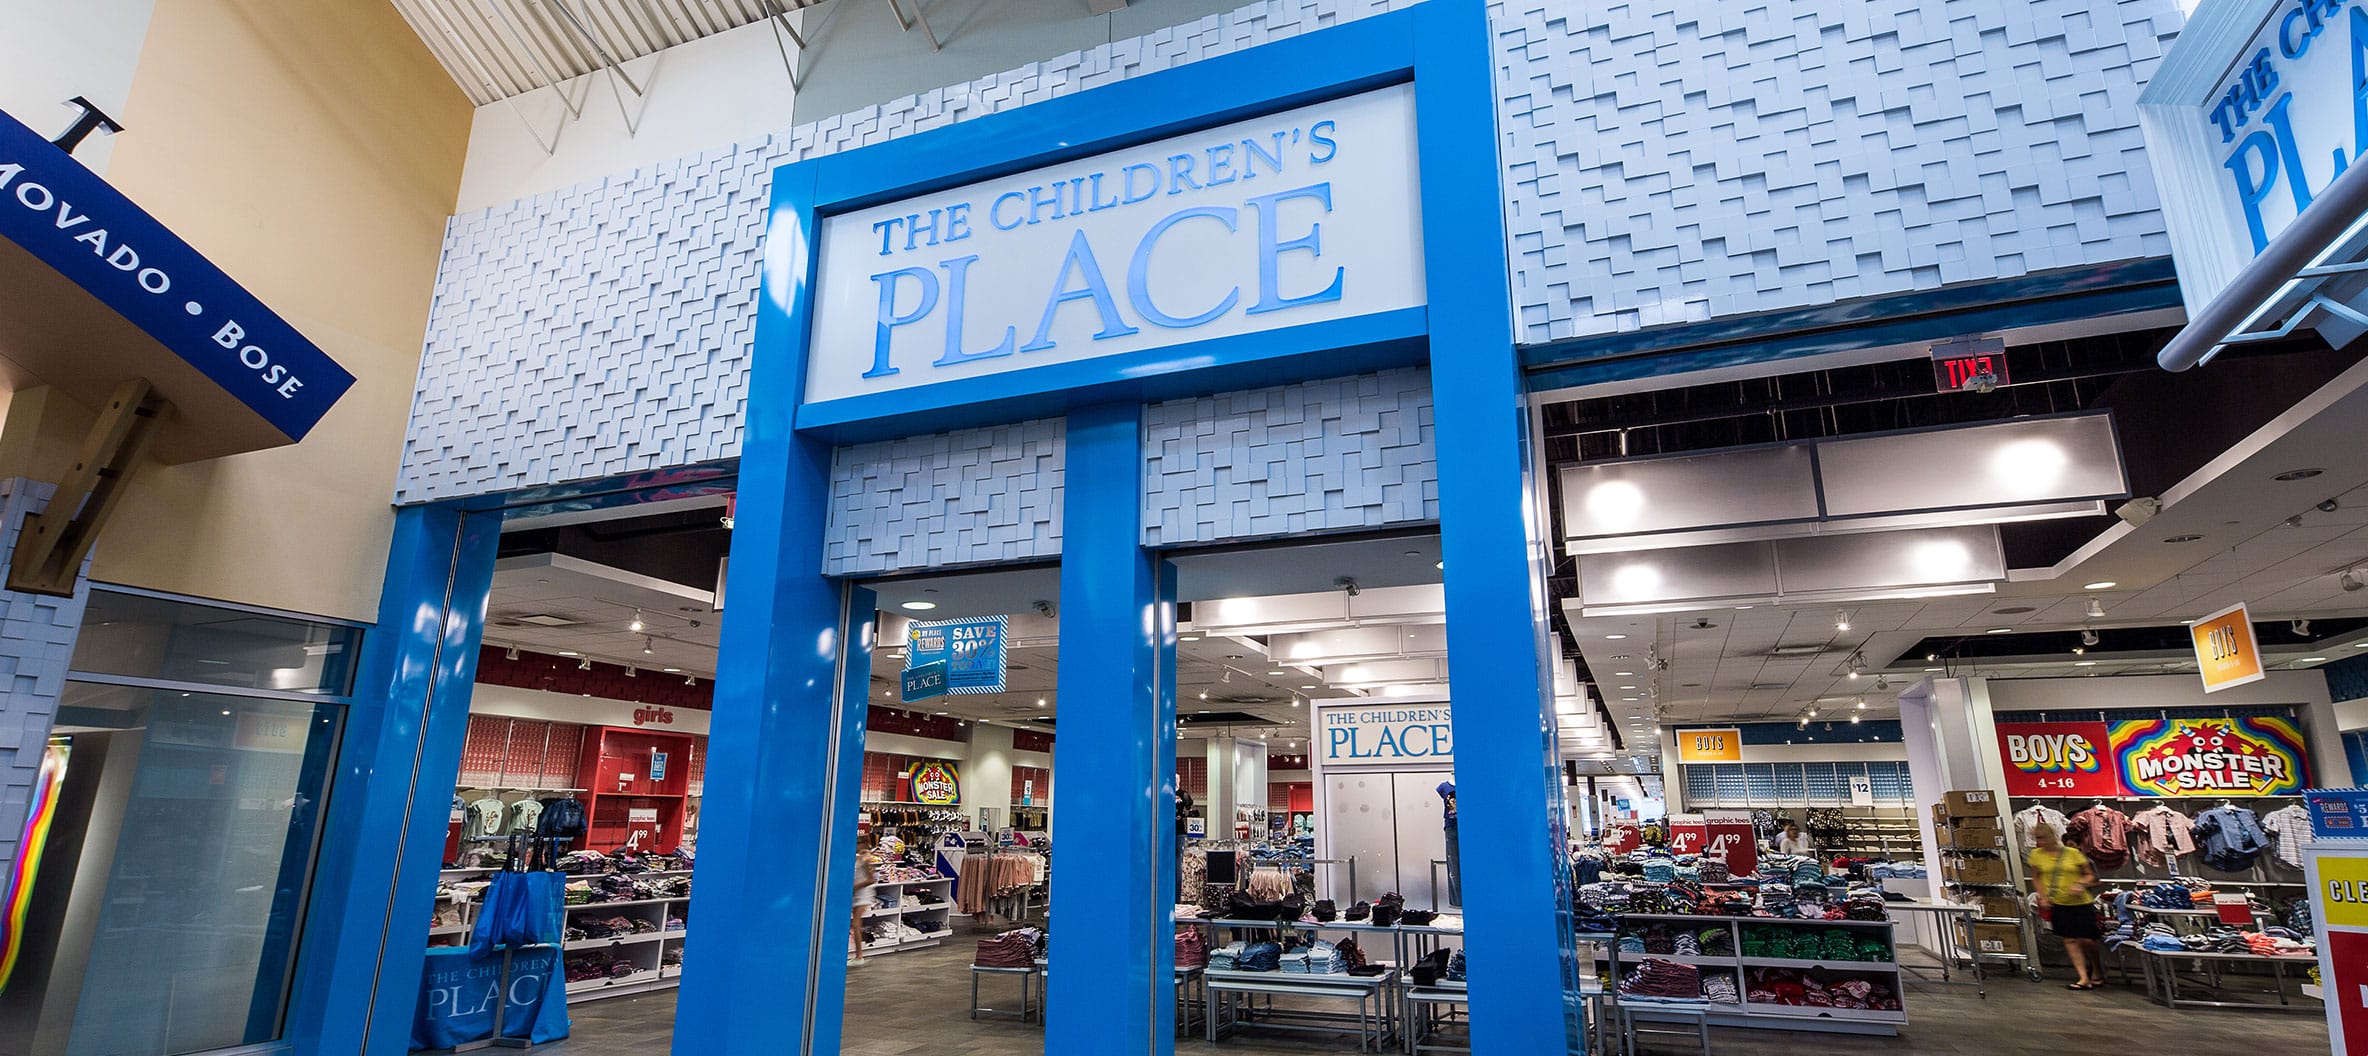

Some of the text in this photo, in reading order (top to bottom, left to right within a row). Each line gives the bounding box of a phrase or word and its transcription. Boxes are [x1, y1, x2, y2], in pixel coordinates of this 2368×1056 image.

[2209, 47, 2279, 143] THE
[872, 120, 1337, 257] THE CHILDREN'S
[861, 180, 1345, 380] PLACE
[211, 319, 304, 400] BOSE
[952, 625, 996, 640] SAVE
[917, 636, 945, 650] REWARDS
[951, 638, 996, 661] 30%
[907, 674, 942, 692] PLACE
[633, 706, 673, 725] girls
[1327, 708, 1451, 725] THE CHILDREN'S
[1328, 724, 1453, 759] PLACE
[1695, 735, 1724, 751] BOYS
[2007, 733, 2091, 765] BOYS
[2137, 752, 2286, 781] MONSTER
[917, 780, 954, 794] MONSTER
[2037, 777, 2075, 789] 4-16
[2176, 770, 2252, 789] SALE
[926, 790, 947, 800] SALE
[1706, 817, 1733, 825] graphic
